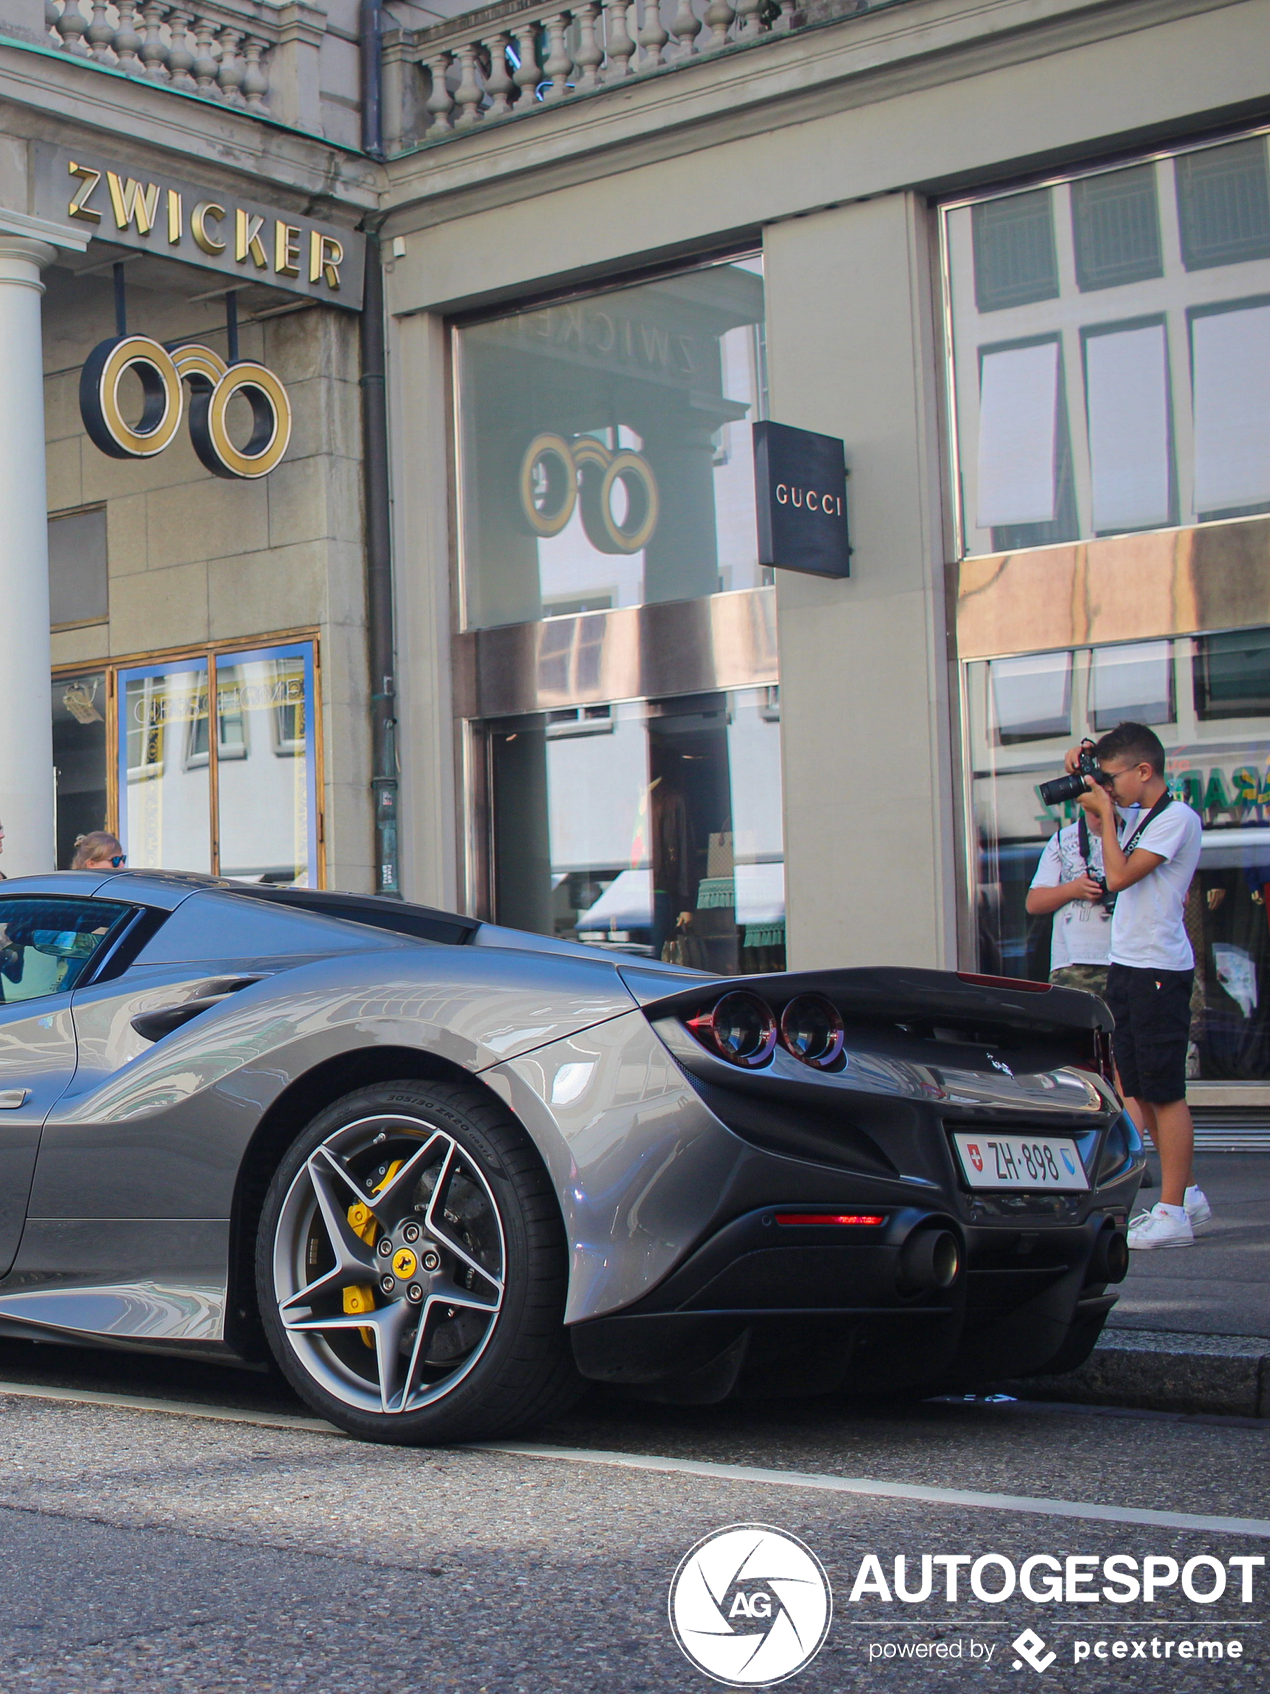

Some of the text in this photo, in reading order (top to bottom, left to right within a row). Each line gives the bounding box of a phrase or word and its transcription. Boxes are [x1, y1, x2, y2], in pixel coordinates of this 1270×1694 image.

[69, 161, 344, 290] ZWICKER
[776, 484, 842, 516] GUCCI
[1124, 831, 1141, 857] SONY
[387, 1094, 434, 1108] 305/30
[435, 1107, 470, 1131] ZR20
